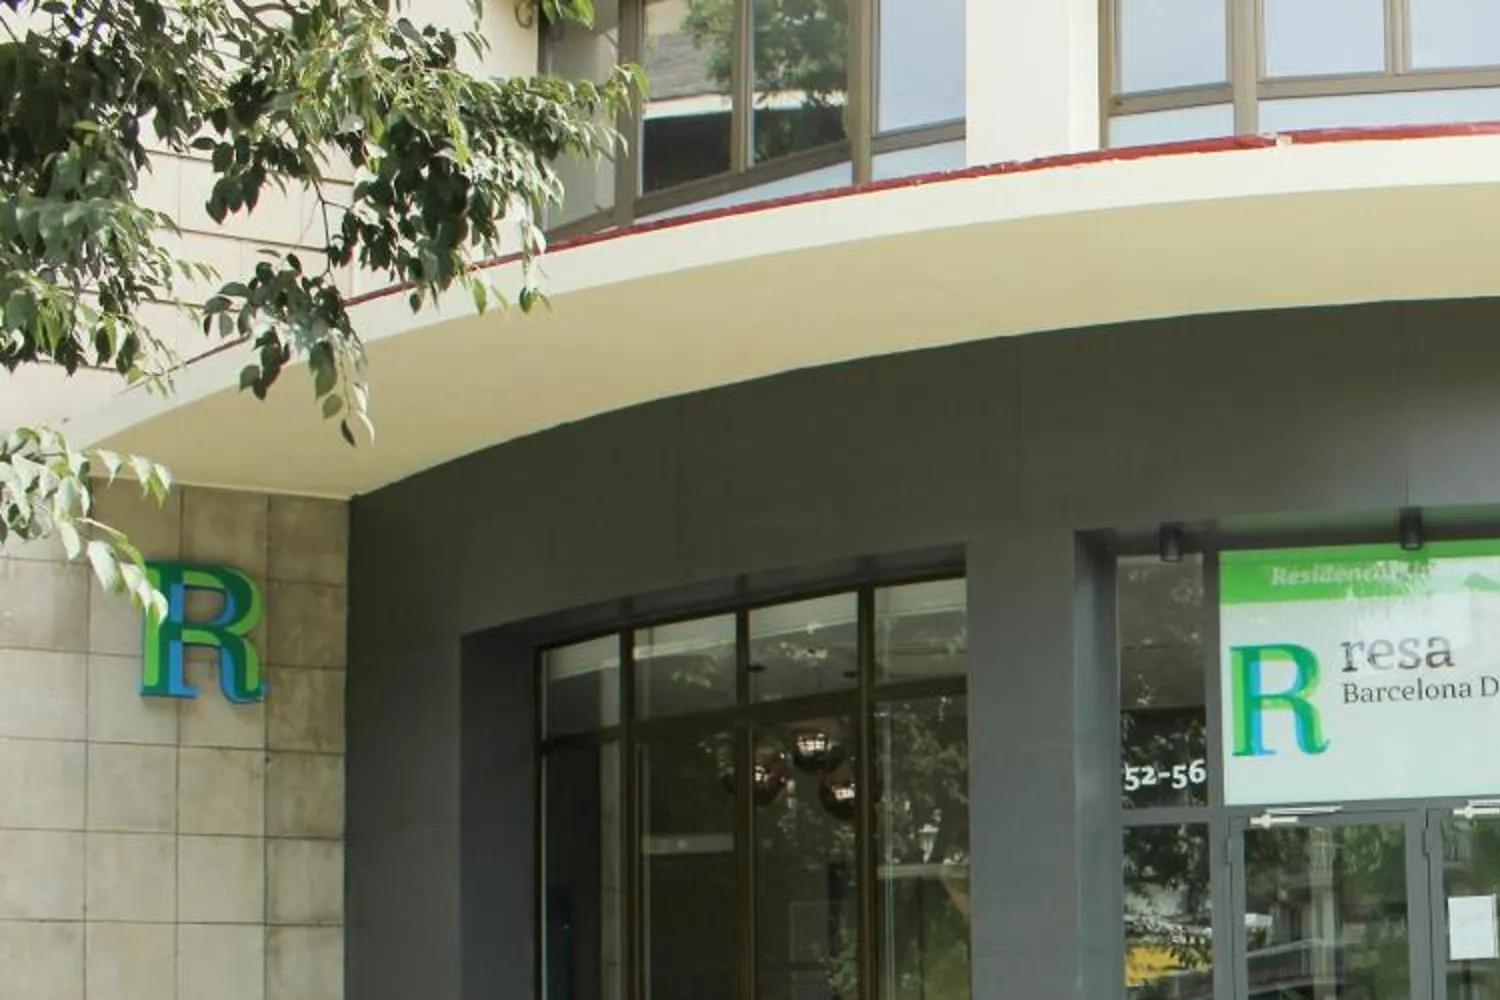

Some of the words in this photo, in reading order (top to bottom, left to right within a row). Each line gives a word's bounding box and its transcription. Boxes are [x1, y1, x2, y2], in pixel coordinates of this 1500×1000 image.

[140, 560, 267, 704] R
[1340, 635, 1456, 673] resa
[1229, 642, 1332, 757] R
[1342, 677, 1472, 704] Barcelona
[1123, 758, 1207, 791] 52-56
